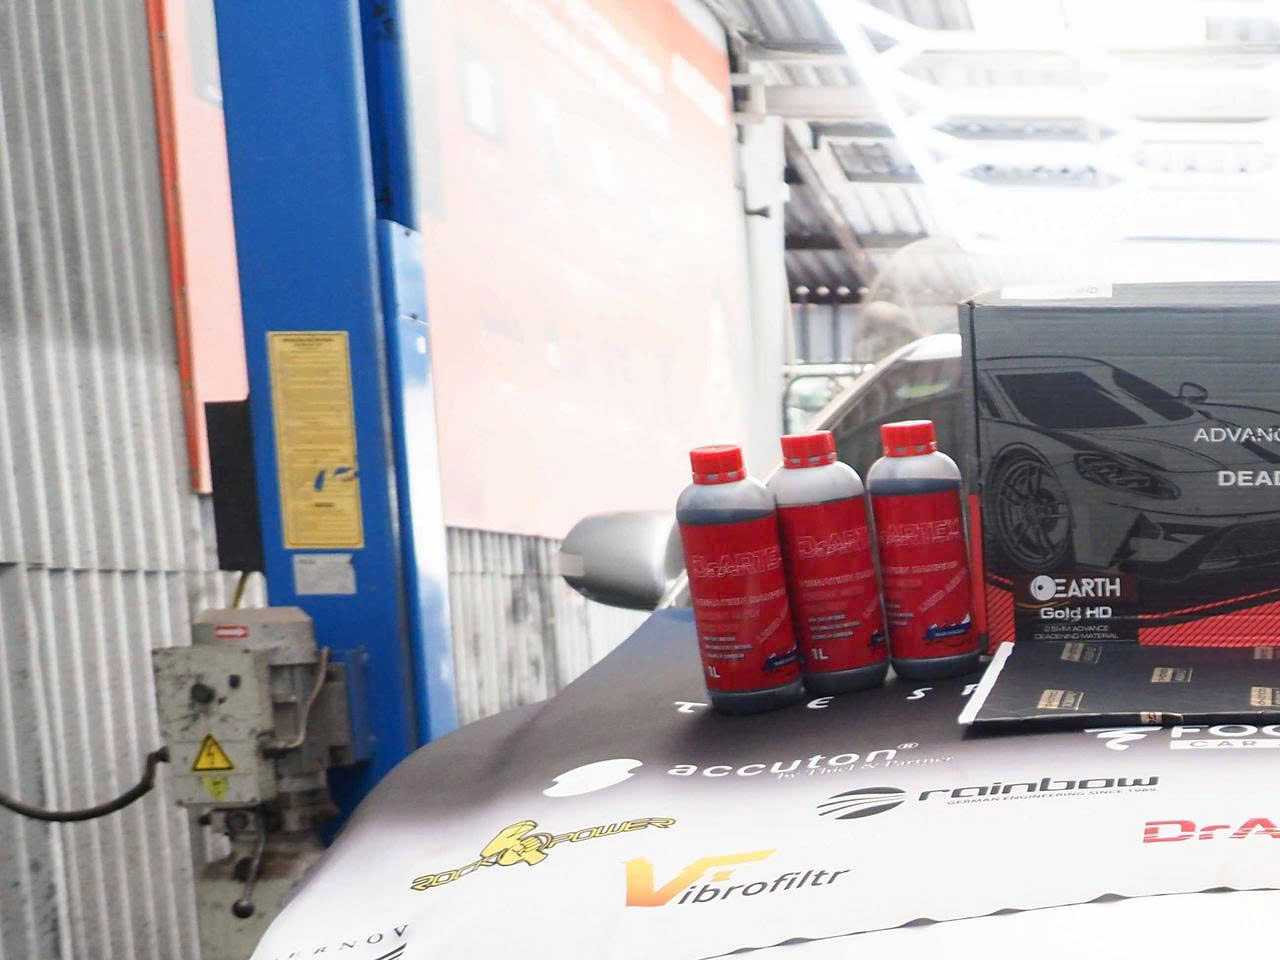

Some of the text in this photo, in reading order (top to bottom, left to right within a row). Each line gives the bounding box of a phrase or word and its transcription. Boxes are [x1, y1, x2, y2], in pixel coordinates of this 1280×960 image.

[1055, 578, 1121, 598] EARTH
[1040, 606, 1113, 620] Gold HD
[1189, 739, 1257, 748] CAR
[918, 776, 1160, 801] rainbow
